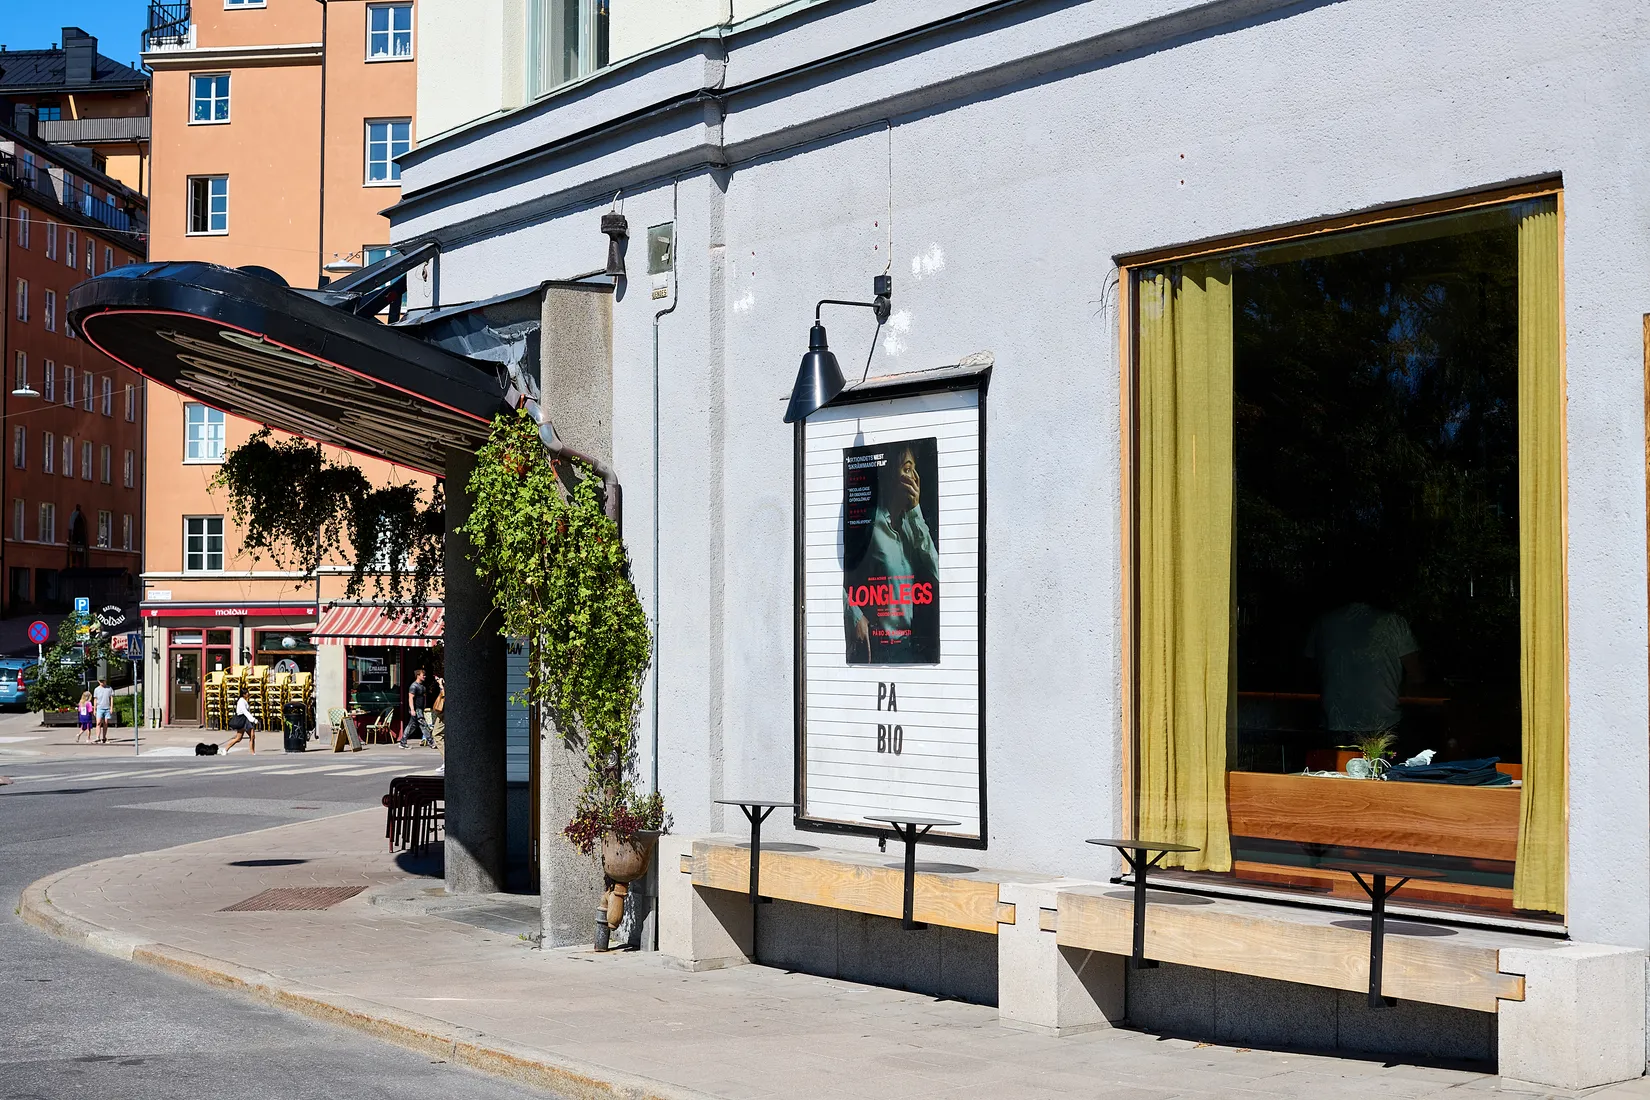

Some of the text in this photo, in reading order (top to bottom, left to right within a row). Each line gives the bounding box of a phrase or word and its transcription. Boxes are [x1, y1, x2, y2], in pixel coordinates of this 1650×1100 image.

[848, 582, 933, 606] LONGLEGS
[78, 599, 87, 611] P
[215, 608, 248, 616] moldau
[97, 613, 126, 627] moldau
[877, 682, 897, 712] PÅ
[877, 724, 903, 756] BIO
